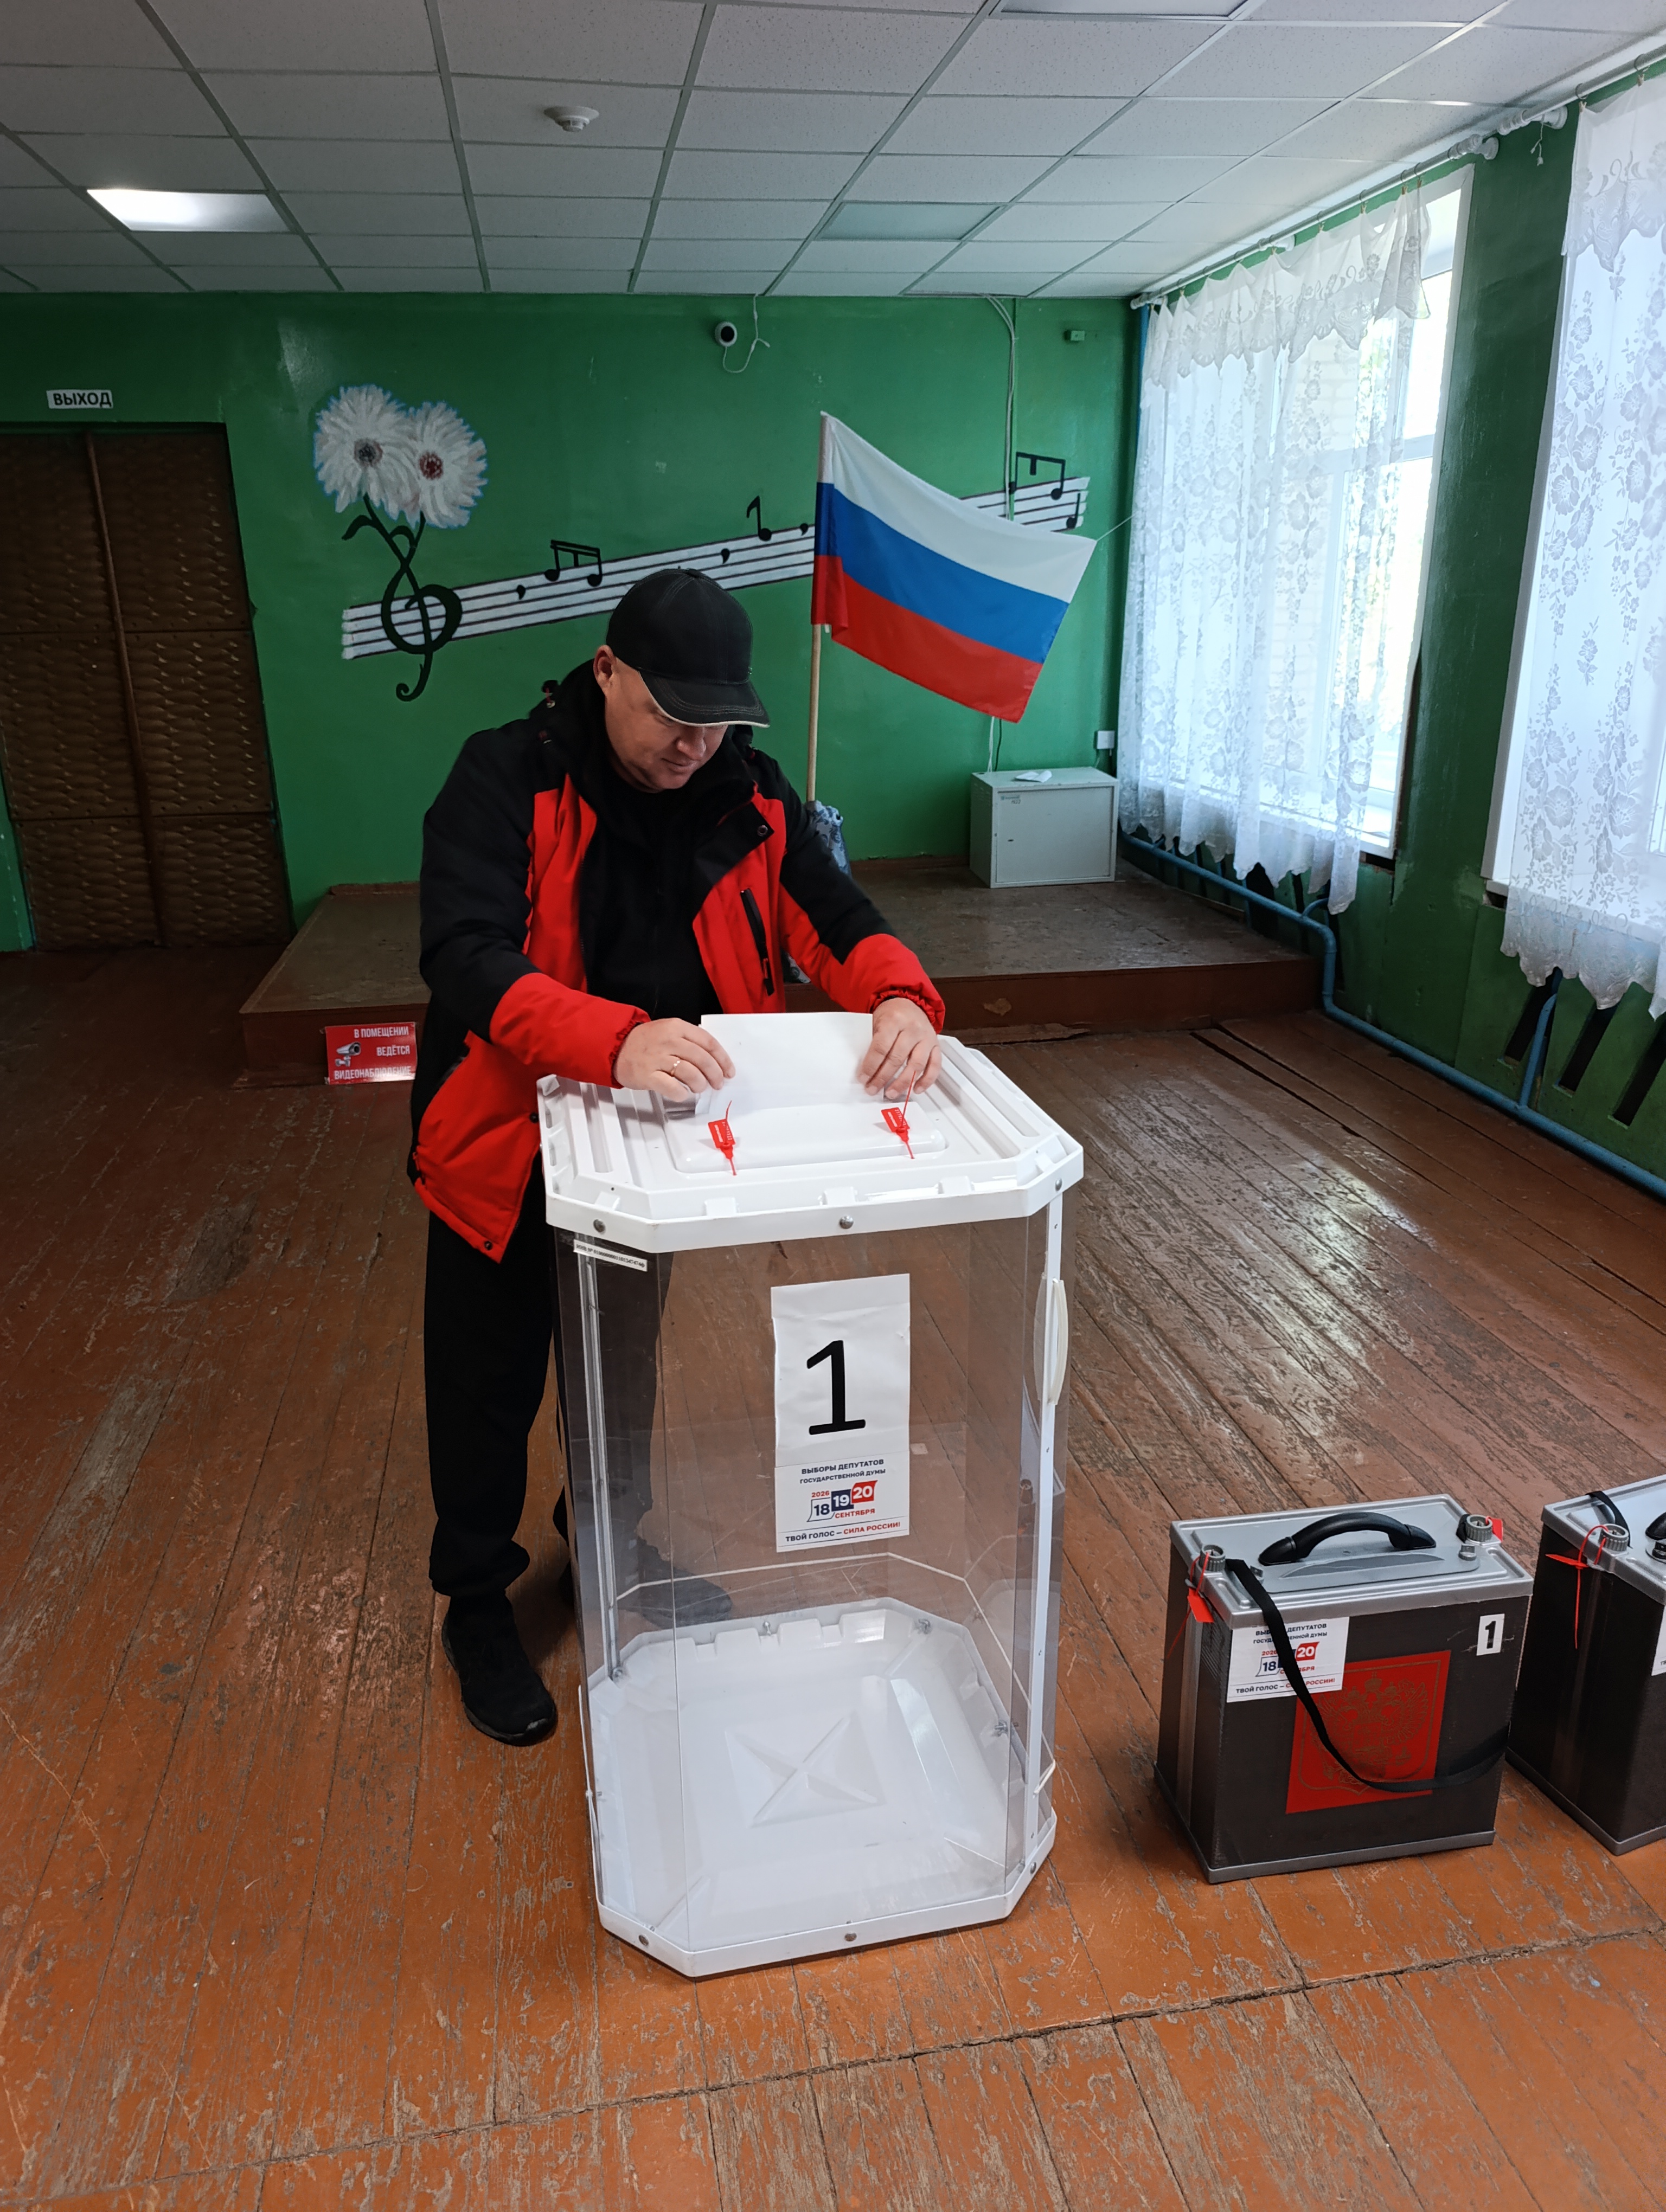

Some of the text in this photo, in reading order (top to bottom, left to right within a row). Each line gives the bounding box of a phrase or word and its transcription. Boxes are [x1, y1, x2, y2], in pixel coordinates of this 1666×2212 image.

[53, 393, 112, 407] ВЫХОД
[354, 1026, 409, 1038] В ПОМЕЩЕНИИ
[376, 1045, 410, 1057] ВЕДЁТСЯ
[334, 1066, 412, 1080] ВИДЕОНАБЛЮДЕНИЕ
[806, 1340, 866, 1436] 1
[802, 1459, 884, 1475] ВЫБОРЫ ДЕПУТАТОВ
[800, 1471, 864, 1484] ГОСУДАРСТВЕННОЙ
[814, 1486, 873, 1516] 18 19 20
[835, 1508, 875, 1519] СЕНТЯБРЯ
[785, 1533, 807, 1542] ТВОЙ
[809, 1531, 835, 1539] ГОЛОС
[843, 1527, 864, 1535] СИЛА
[867, 1522, 900, 1531] РОССИИ!
[1287, 1623, 1327, 1633] ДЕПУТАТОВ
[1485, 1621, 1496, 1649] 1
[1263, 1646, 1315, 1671] 18 20
